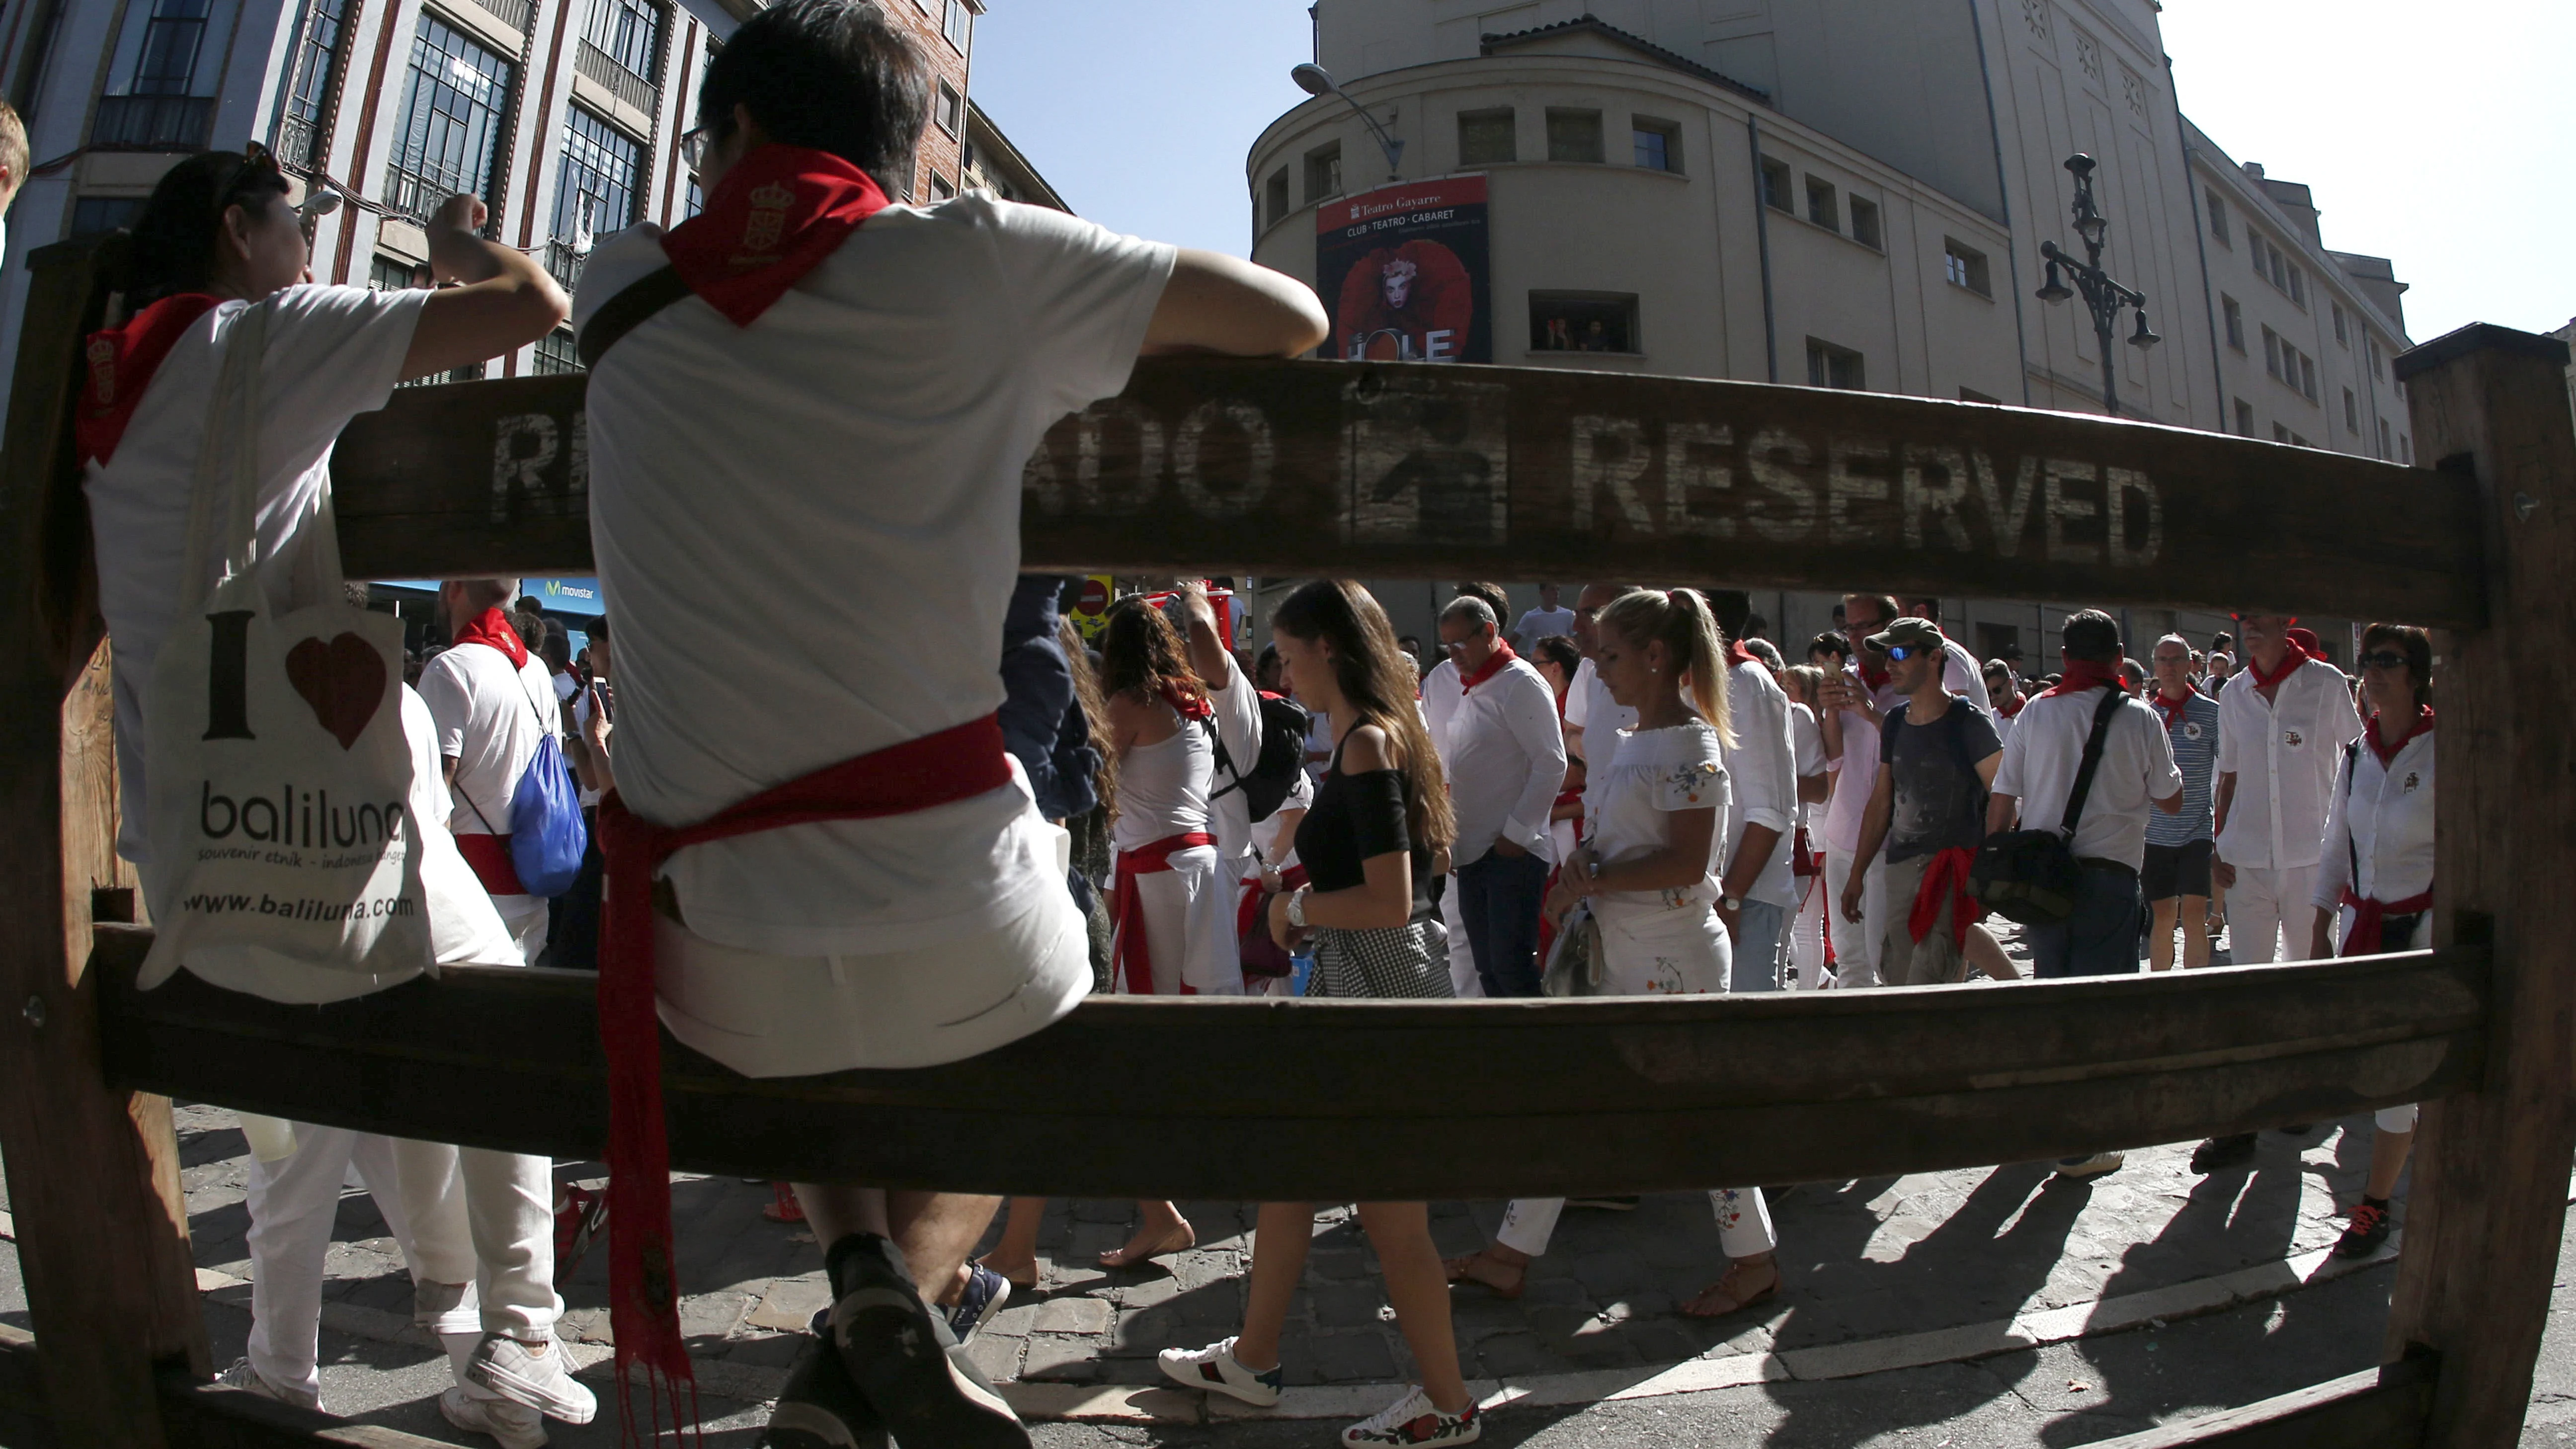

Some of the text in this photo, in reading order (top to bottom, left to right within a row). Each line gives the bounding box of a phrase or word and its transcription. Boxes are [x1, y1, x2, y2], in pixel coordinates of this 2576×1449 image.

[1361, 195, 1441, 217] Teatro Gayarre
[1347, 225, 1367, 238] CLUB
[1372, 216, 1405, 231] TEATRO
[1412, 209, 1454, 223] CABARET
[1572, 414, 2164, 567] RESERVED
[562, 586, 594, 599] movistar
[202, 610, 256, 741] I
[201, 779, 405, 848] baliluna
[198, 846, 260, 862] souvenir
[265, 850, 302, 867] etnik
[183, 893, 414, 921] www.baliluna.com
